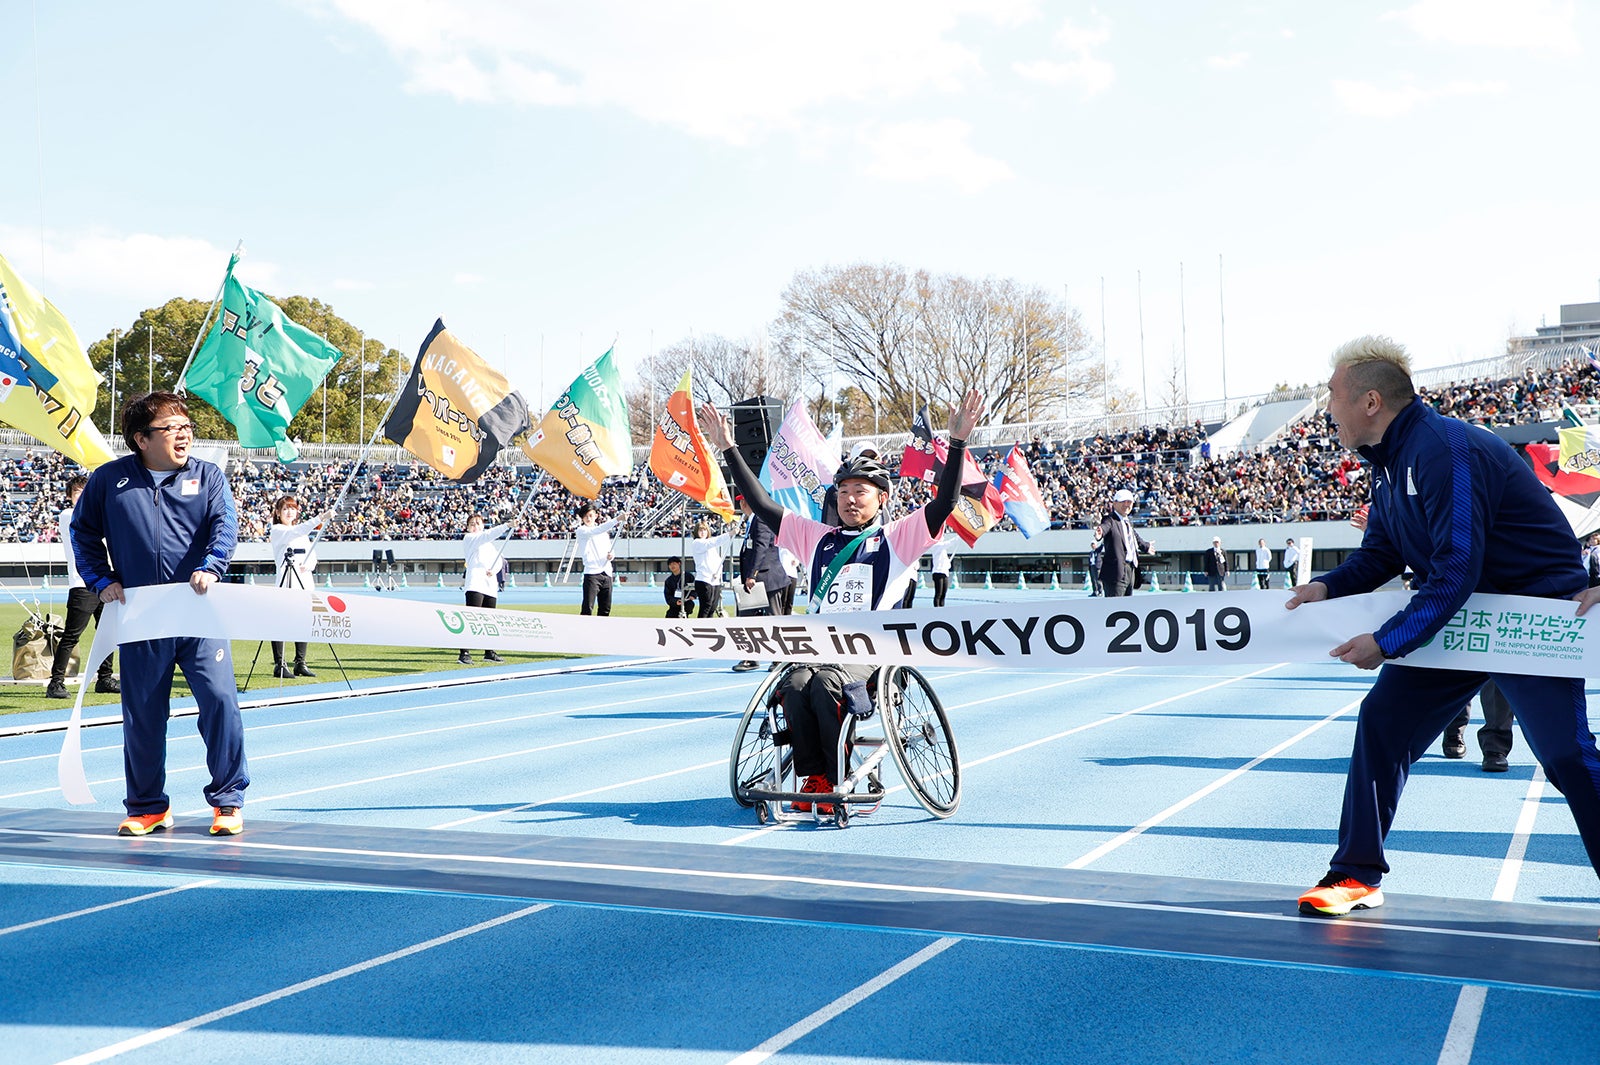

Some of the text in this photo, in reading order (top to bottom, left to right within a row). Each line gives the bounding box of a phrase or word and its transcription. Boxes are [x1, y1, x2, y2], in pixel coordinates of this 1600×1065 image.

[423, 353, 488, 409] NAGANO
[827, 582, 840, 605] 6
[845, 579, 864, 590] 栃木
[842, 591, 864, 604] 8区
[312, 614, 352, 628] パラ駅伝
[1446, 608, 1493, 629] 日本
[1497, 611, 1587, 630] パラリンピック
[311, 627, 352, 639] in TOKYO
[655, 606, 1252, 657] パラ駅伝 in TOKYO 2019
[1496, 626, 1585, 644] サポートセンター
[1443, 630, 1491, 653] 財団
[1494, 640, 1584, 653] THE NIPPON FOUNDATION
